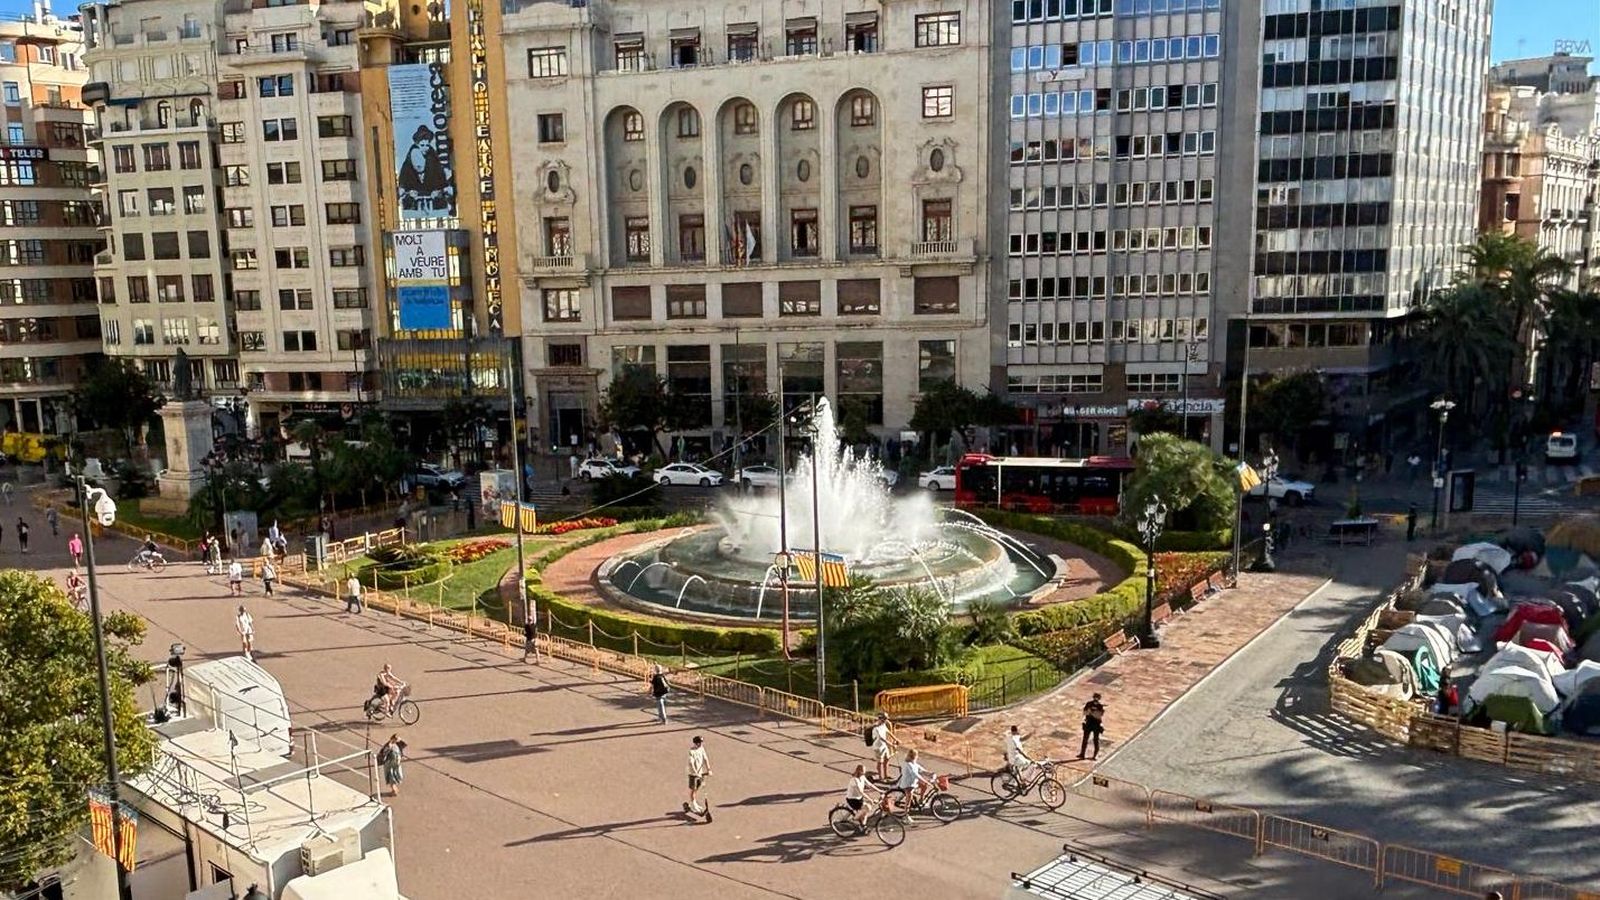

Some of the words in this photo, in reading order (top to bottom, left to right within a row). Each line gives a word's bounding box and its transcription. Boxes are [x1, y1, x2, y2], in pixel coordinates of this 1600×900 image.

[1554, 39, 1592, 54] BBVA
[476, 110, 493, 194] TEATRE
[395, 234, 423, 246] MOLT
[416, 246, 424, 256] A
[410, 256, 446, 268] VEURE
[399, 268, 423, 279] AMB
[431, 267, 446, 278] TU
